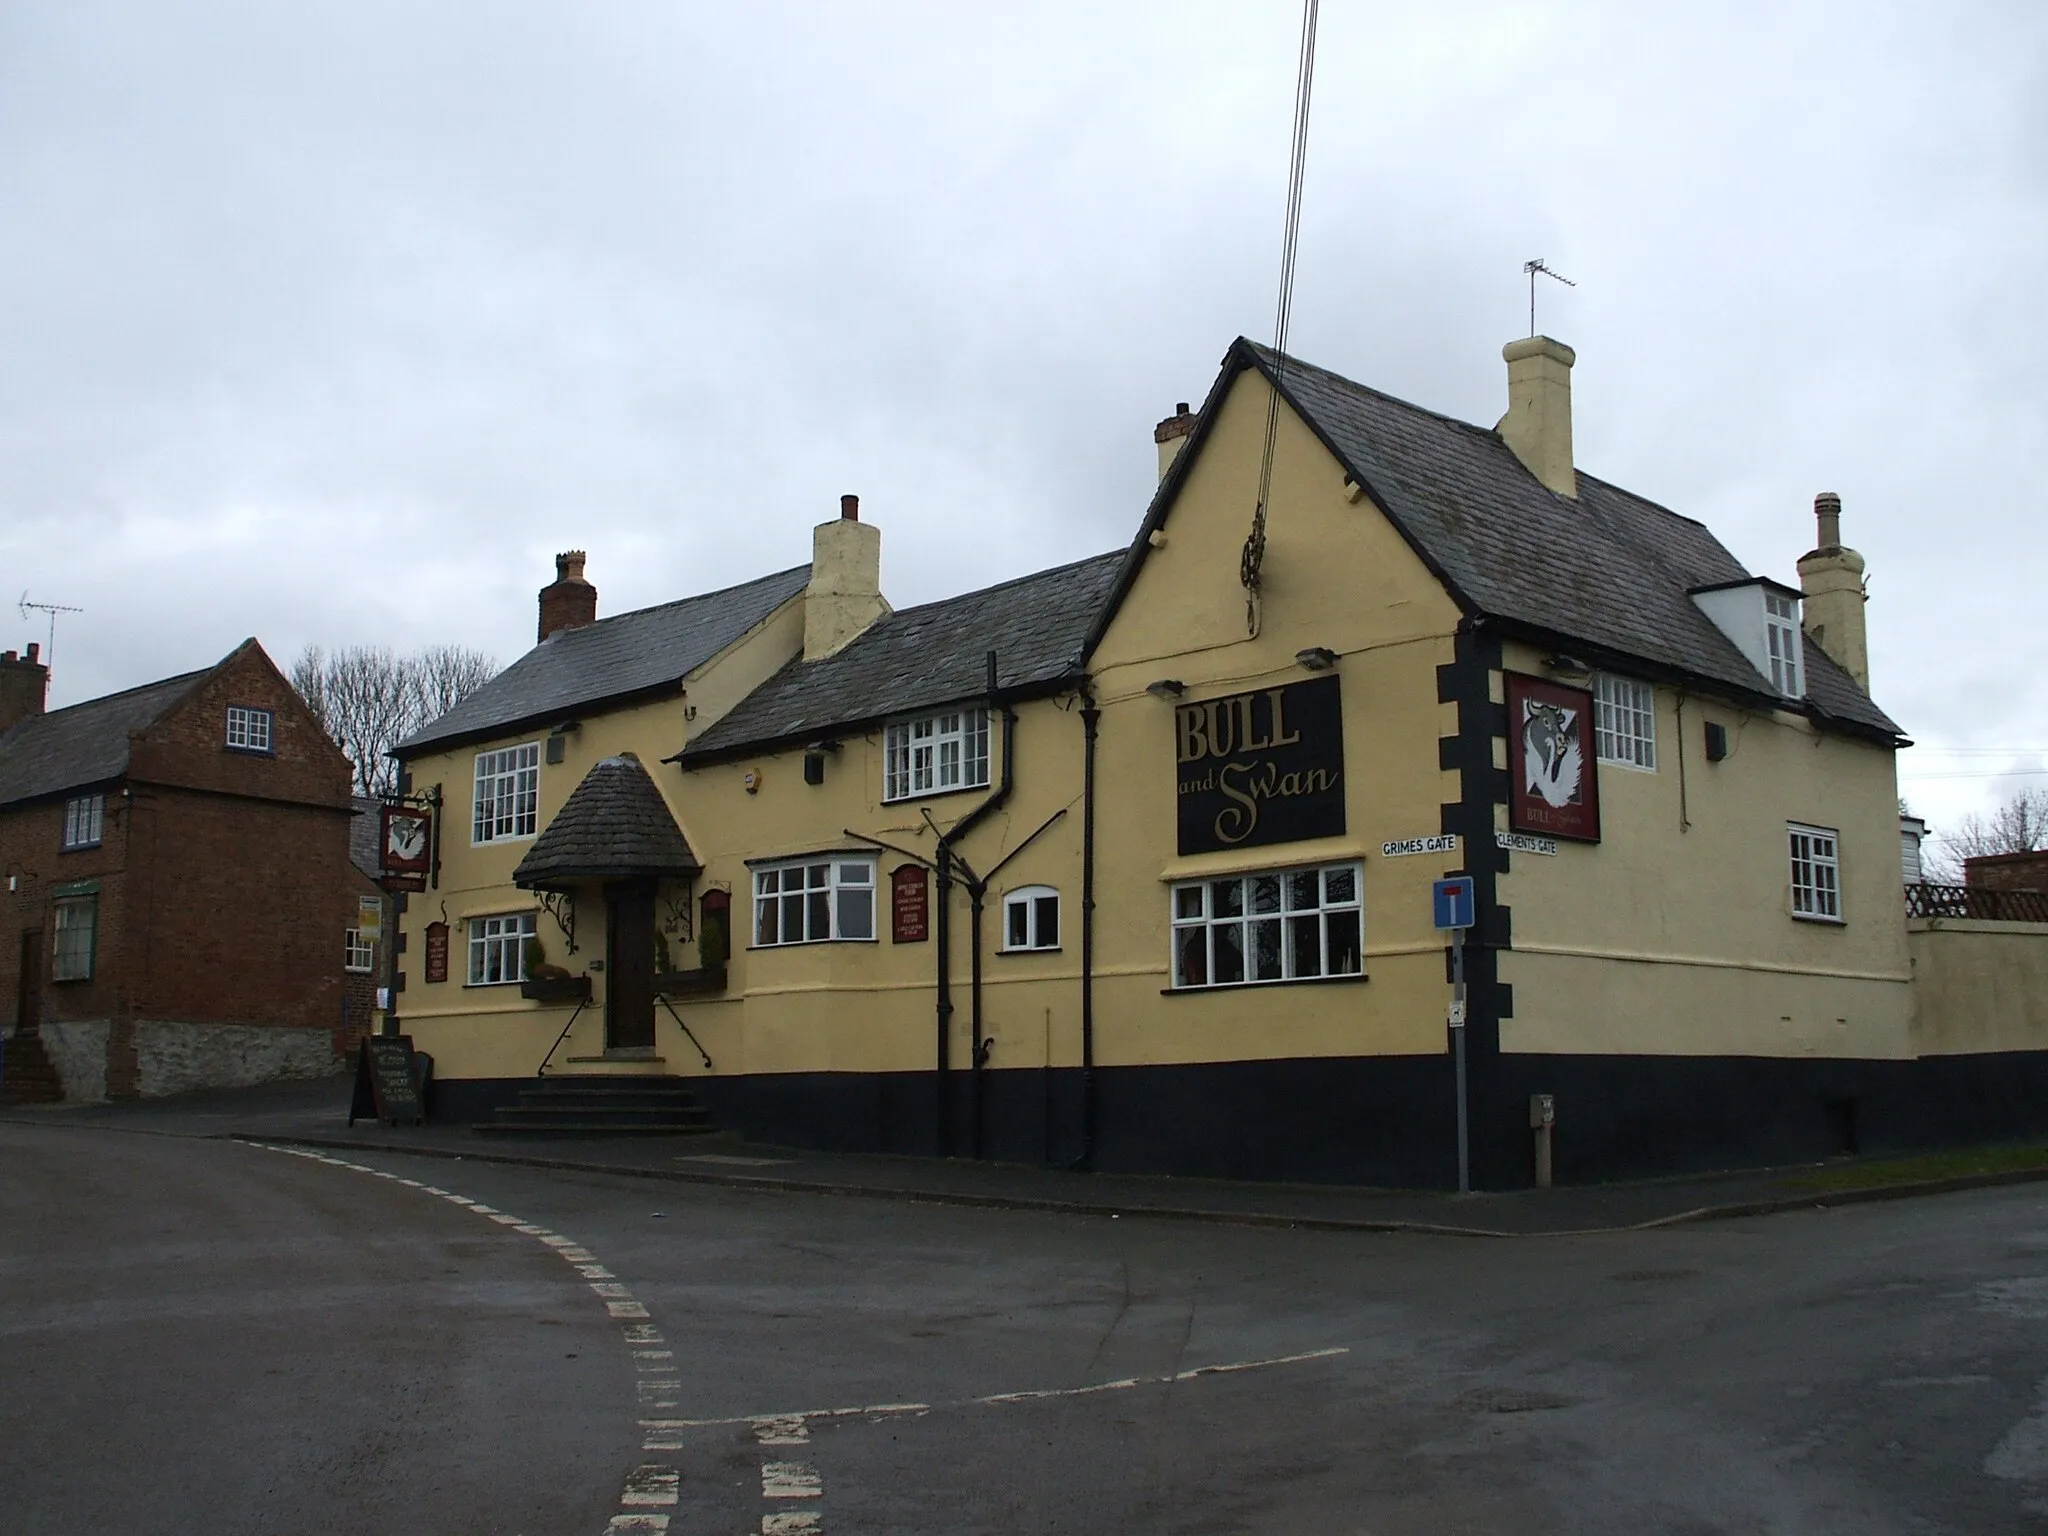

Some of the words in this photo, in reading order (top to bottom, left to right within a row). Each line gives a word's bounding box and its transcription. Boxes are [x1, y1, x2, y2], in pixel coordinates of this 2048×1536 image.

[1176, 689, 1299, 763] BULL
[1178, 768, 1217, 795] and
[1214, 760, 1338, 843] Swan
[1527, 807, 1549, 823] BULL
[1383, 839, 1423, 855] GRIMES
[1427, 836, 1455, 850] GATE
[1498, 833, 1536, 850] CLEMENTS
[1539, 840, 1557, 854] GATE
